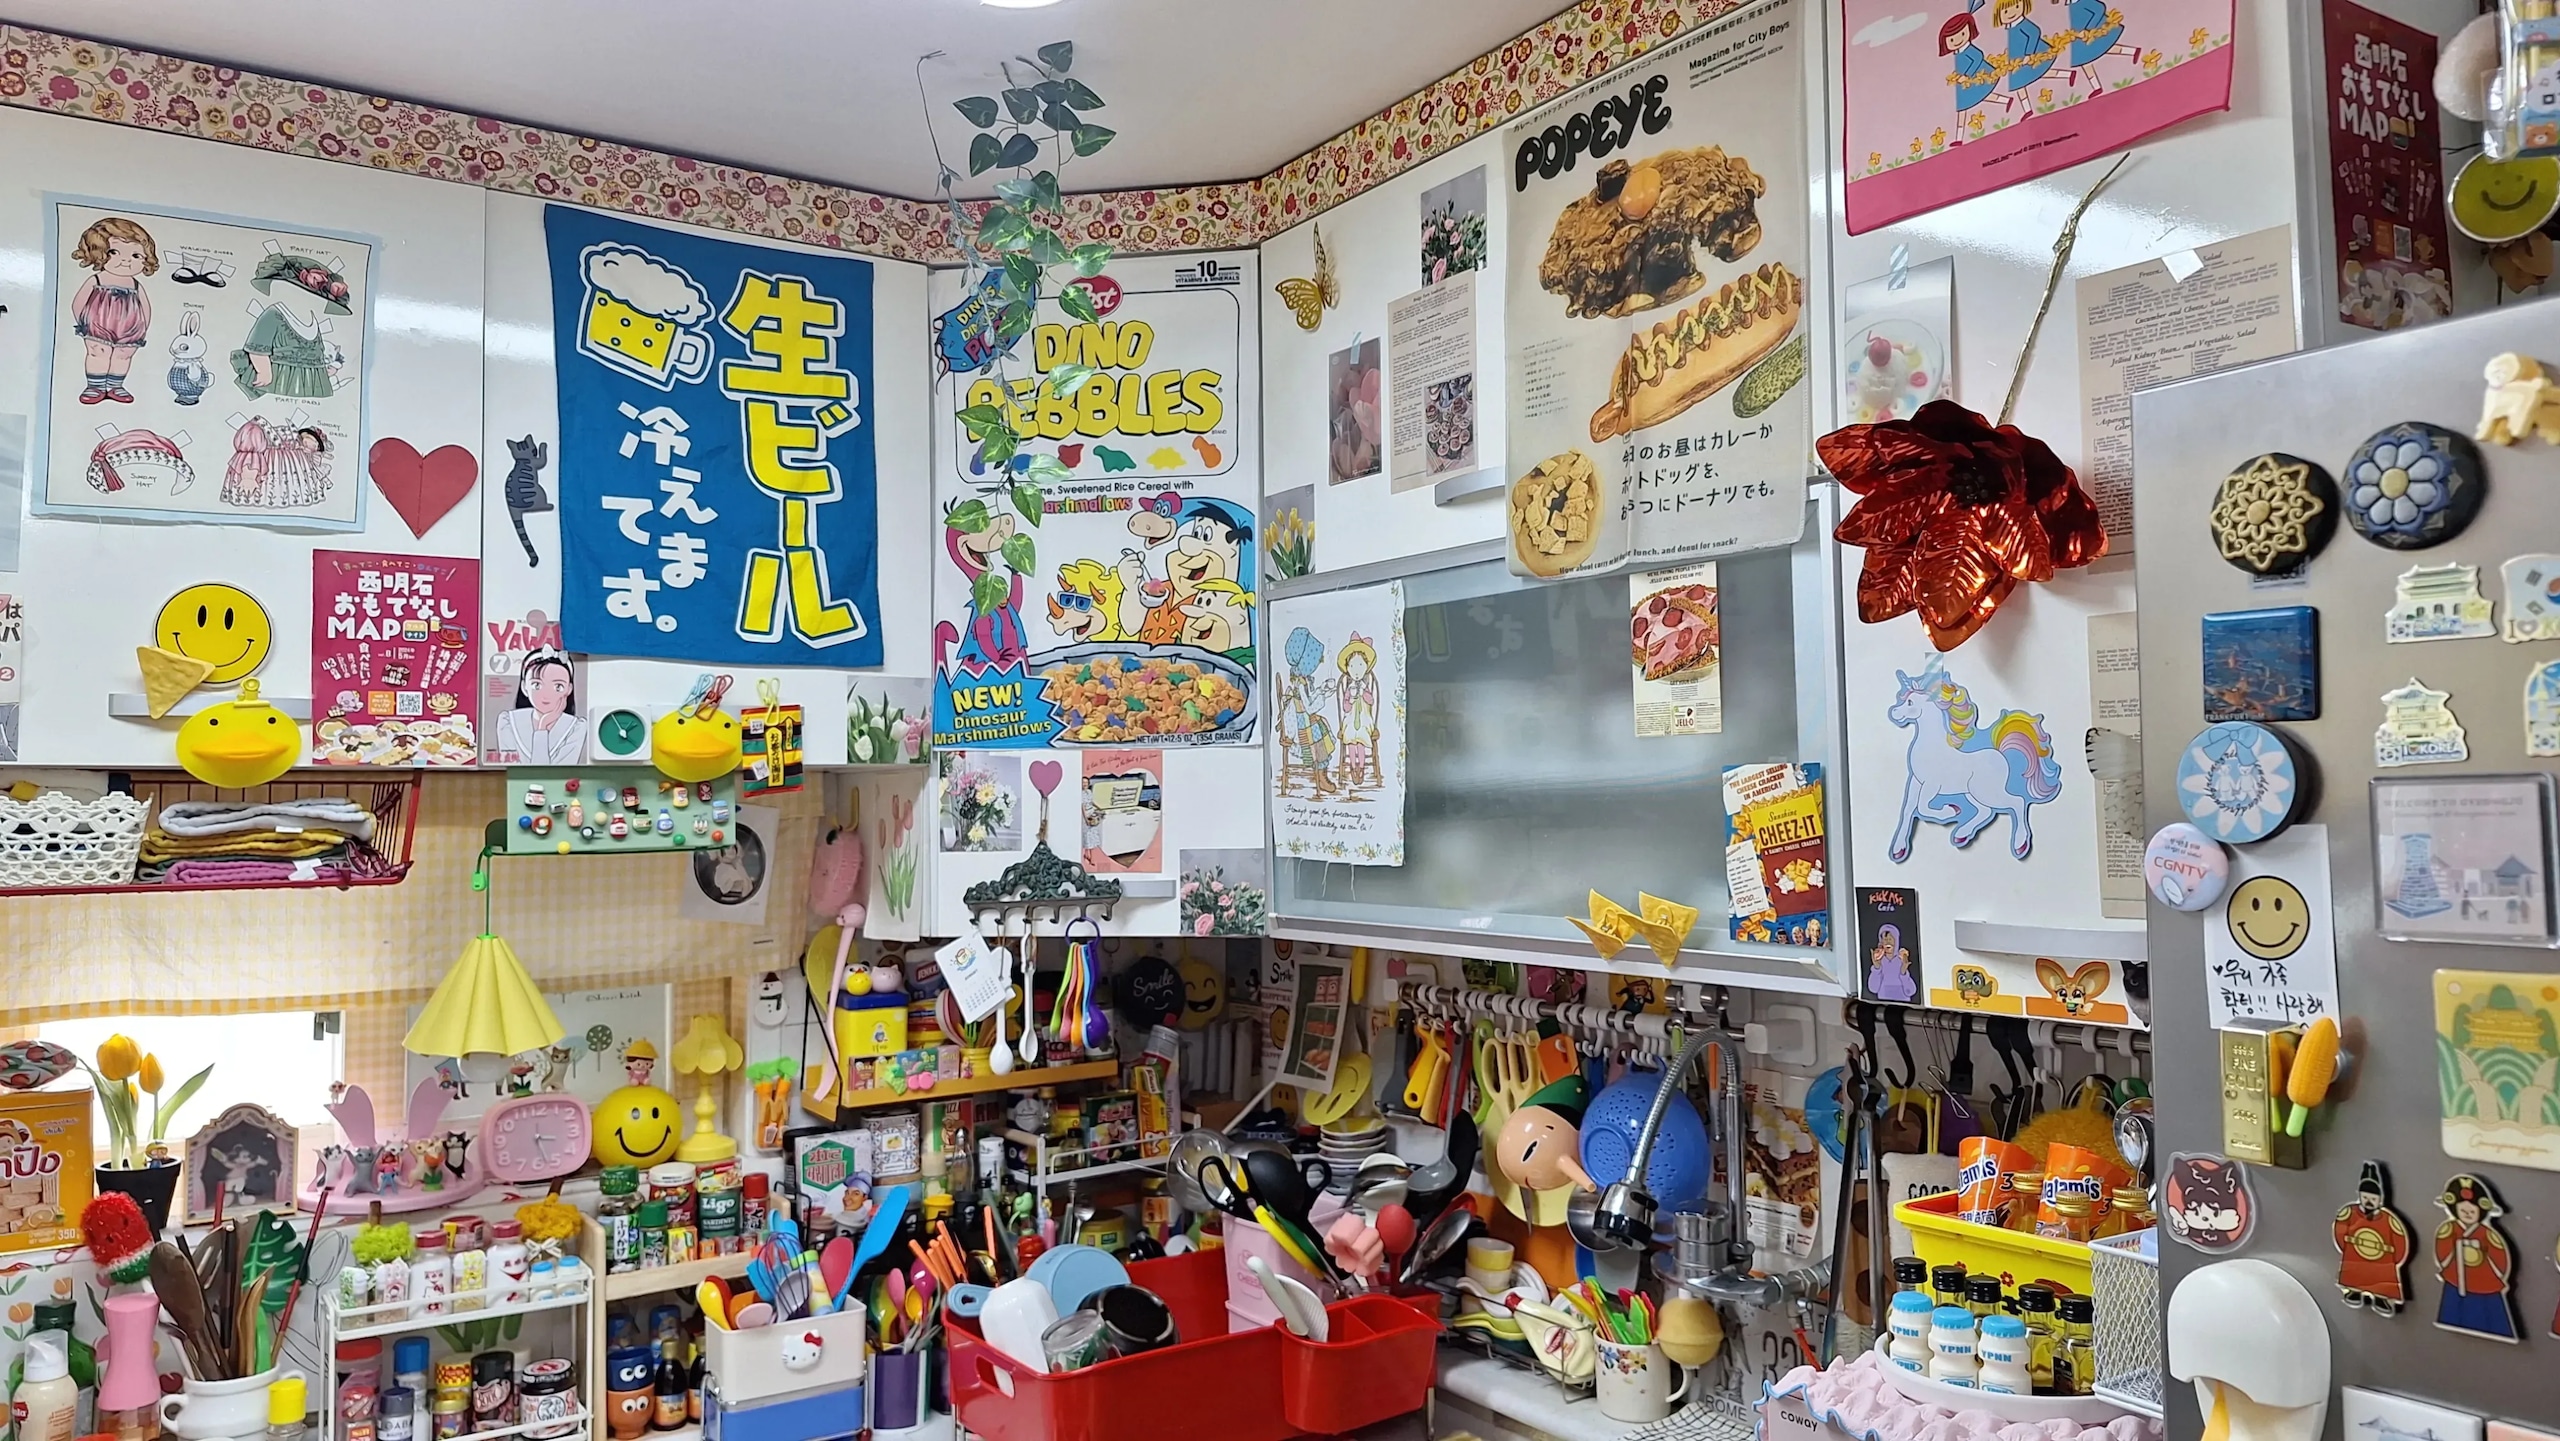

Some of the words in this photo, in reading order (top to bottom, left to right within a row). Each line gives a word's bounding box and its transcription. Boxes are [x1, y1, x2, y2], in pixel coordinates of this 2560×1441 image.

[1689, 46, 1730, 71] Magazine
[1733, 39, 1746, 52] for
[1748, 30, 1767, 47] City
[1770, 20, 1790, 36] Boys
[2354, 33, 2407, 82] 西明石
[2341, 62, 2426, 121] おもてなし
[2339, 97, 2389, 143] MAP
[1515, 74, 1672, 193] POPEYE
[315, 248, 332, 256] HAT
[2203, 251, 2222, 262] Salad
[1197, 260, 1218, 276] 10
[2134, 311, 2167, 325] Cucumber
[2168, 308, 2182, 317] and
[2209, 296, 2230, 308] Salad
[1033, 320, 1155, 373] DINO
[2133, 350, 2157, 363] Kidney
[2159, 345, 2181, 355] Bean
[2182, 341, 2197, 350] and
[2198, 333, 2234, 348] Vegetable
[2236, 327, 2256, 339] Salad
[275, 396, 296, 405] PARTY
[718, 268, 868, 649] 生ビール
[1057, 484, 1112, 494] Sweetened
[1113, 482, 1135, 492] Rice
[1137, 481, 1171, 491] Cereal
[1173, 480, 1194, 490] with
[1042, 496, 1133, 514] arshmallows
[601, 400, 718, 632] 冷えてます。
[1633, 548, 1660, 556] lunch,
[1661, 545, 1675, 554] and
[1677, 543, 1698, 553] donut
[1700, 542, 1711, 550] for
[1712, 537, 1738, 548] snack?
[357, 570, 434, 597] 西明石
[334, 592, 458, 619] おもてなし
[327, 616, 401, 641] MAP
[493, 655, 507, 673] 7
[952, 682, 1022, 715] NEW!
[953, 708, 1027, 730] Dinosaur
[933, 721, 1052, 746] Marshmallows
[1729, 781, 1740, 789] THE
[1740, 771, 1765, 785] LARGEST
[1765, 763, 1788, 775] SELLING
[1737, 783, 1757, 794] CHEESE
[1758, 773, 1785, 786] CRACKER
[1752, 782, 1782, 798] AMERICA!
[1768, 809, 1797, 822] Sunshine
[1759, 815, 1817, 846] CHEEZ-IT
[1801, 839, 1820, 847] CRACKER
[2154, 856, 2208, 880] CGNTV
[1877, 903, 1895, 912] Cafe
[2223, 959, 2253, 987] 우리
[2259, 961, 2288, 987] 가족
[1133, 969, 1175, 997] Smile
[2276, 992, 2324, 1022] 사랑해
[2225, 1072, 2265, 1092] GOLD
[514, 1109, 527, 1119] 11
[531, 1104, 547, 1117] 12
[553, 1104, 559, 1114] 1
[564, 1107, 576, 1120] 2
[497, 1119, 514, 1132] 10
[567, 1124, 579, 1139] 3
[494, 1135, 506, 1149] 9
[564, 1142, 576, 1155] 4
[498, 1151, 511, 1166] 8
[516, 1158, 527, 1172] 7
[532, 1157, 545, 1171] 6
[549, 1153, 560, 1167] 5
[2001, 1172, 2014, 1191] 3
[702, 1197, 735, 1214] Ligo
[57, 1228, 75, 1240] 350
[617, 1219, 627, 1257] ふりかけ
[1892, 1326, 1919, 1337] YPNN
[1939, 1344, 1971, 1354] YPNN
[1982, 1350, 2012, 1363] YPNN
[1706, 1393, 1747, 1422] ROME
[1780, 1408, 1818, 1431] coway
